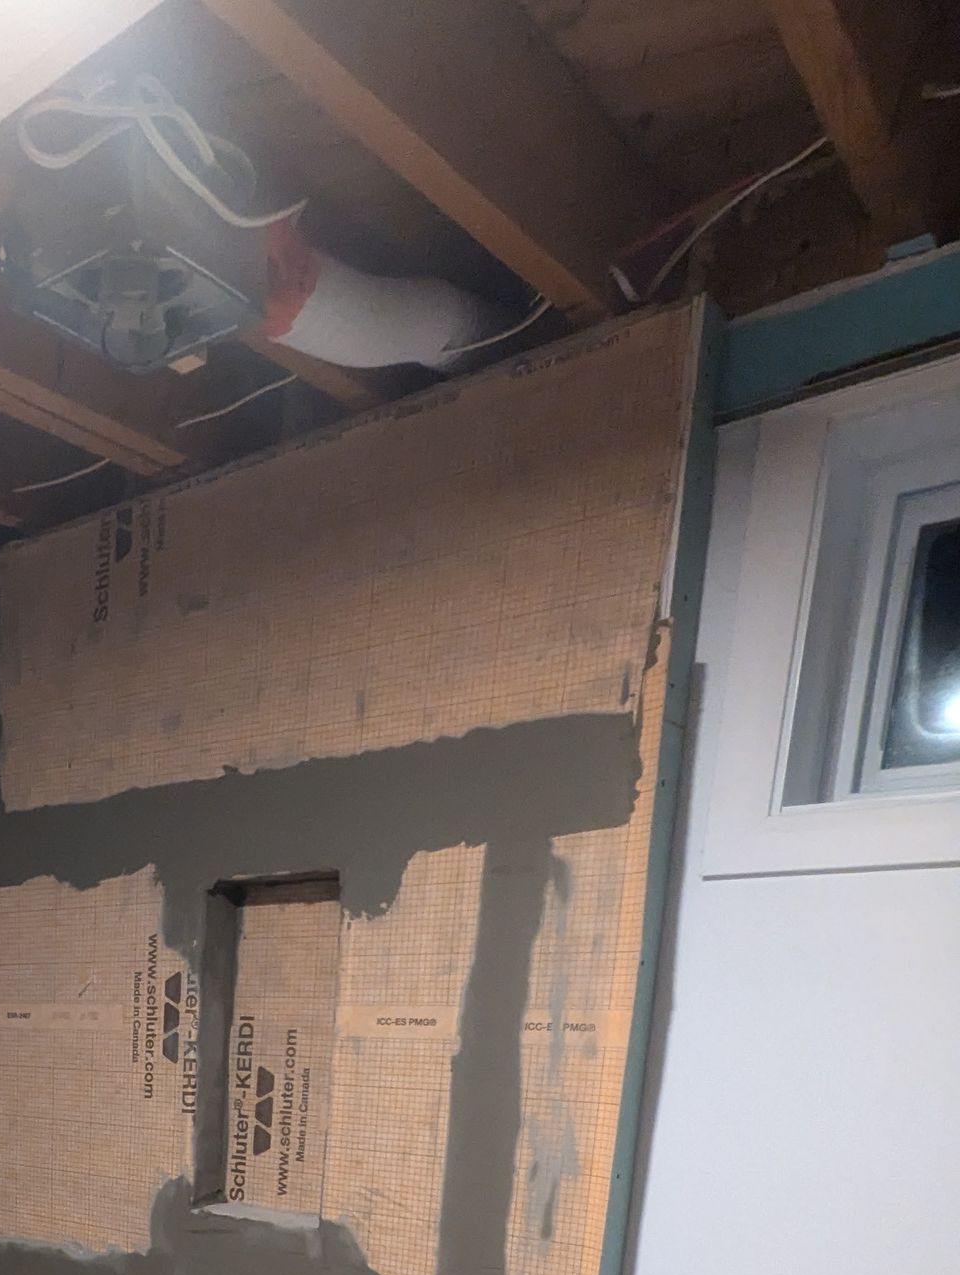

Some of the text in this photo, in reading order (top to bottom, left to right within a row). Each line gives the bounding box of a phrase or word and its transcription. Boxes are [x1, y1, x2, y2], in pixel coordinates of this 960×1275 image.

[134, 971, 143, 1004] Made
[144, 933, 159, 1100] www.schluter.com
[376, 1017, 407, 1026] ICC-ES
[524, 1022, 553, 1032] ICC-E
[132, 1017, 143, 1063] Canada
[299, 1067, 311, 1117] Canada
[277, 1028, 297, 1197] www.schluter.com
[295, 1130, 306, 1163] Made
